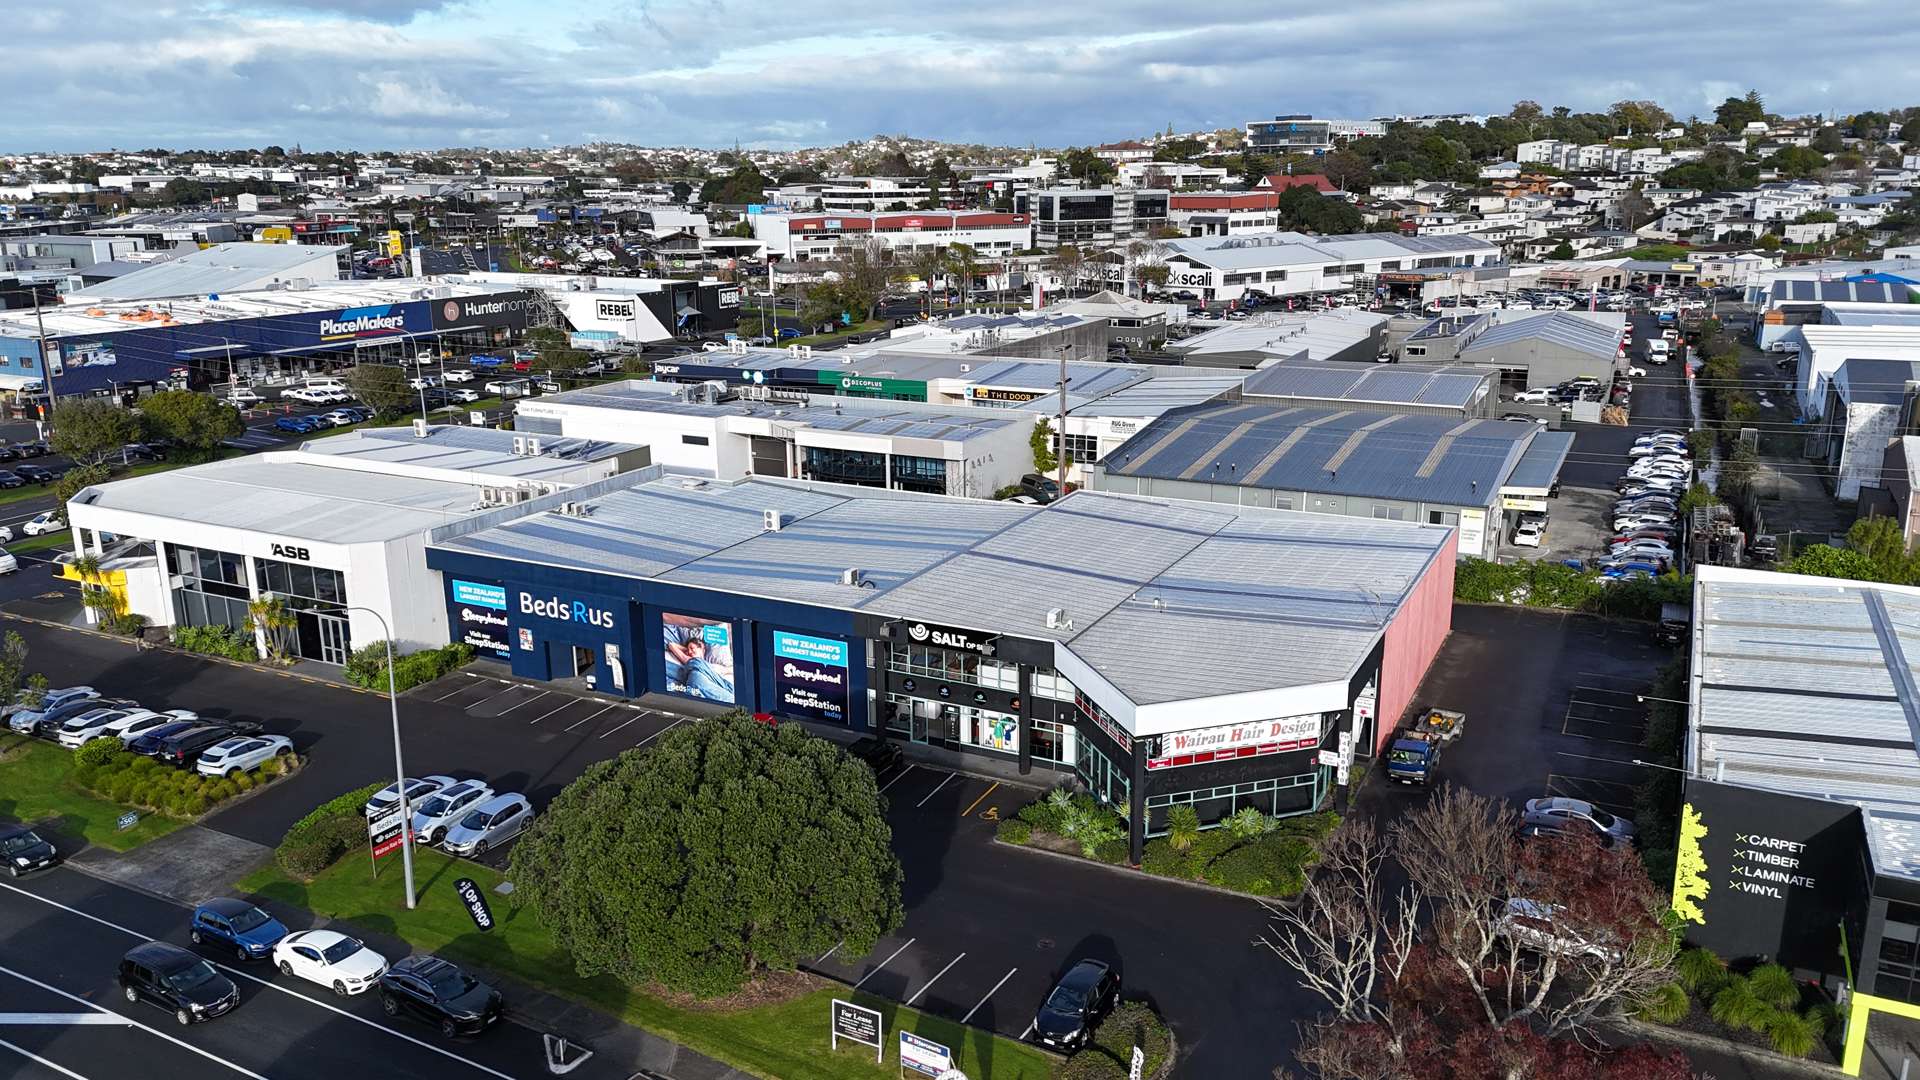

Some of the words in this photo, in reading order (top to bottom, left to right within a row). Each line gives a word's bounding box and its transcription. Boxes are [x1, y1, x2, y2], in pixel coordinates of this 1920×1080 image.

[465, 299, 534, 316] Hunterhome
[600, 304, 632, 316] REBEL
[320, 315, 404, 335] PlaceMakers
[654, 364, 680, 374] jaycar
[991, 391, 1008, 400] THE
[459, 585, 473, 593] NEW
[462, 608, 508, 626] Sleepyhead
[469, 630, 481, 638] Visit
[932, 631, 967, 648] SALT
[464, 636, 510, 652] SleepStation
[782, 638, 799, 648] NEW
[800, 640, 841, 654] ZEALAND'S
[496, 650, 511, 659] today
[782, 646, 809, 656] LARGEST
[810, 650, 831, 660] RANGE
[783, 663, 842, 685] Sleepyhead
[791, 688, 807, 698] Visit
[784, 694, 841, 712] SleepStation
[824, 711, 842, 720] today
[1175, 733, 1225, 750] Wairau
[1230, 725, 1264, 743] Hair
[1270, 719, 1316, 738] Design
[1749, 834, 1807, 853] CARPET
[1747, 849, 1800, 869] TIMBER
[1744, 865, 1816, 889] LAMINATE
[465, 889, 478, 902] OP
[1742, 881, 1782, 899] VINYL
[471, 901, 490, 927] SHOP
[841, 1009, 853, 1017] For
[853, 1013, 872, 1025] Lease
